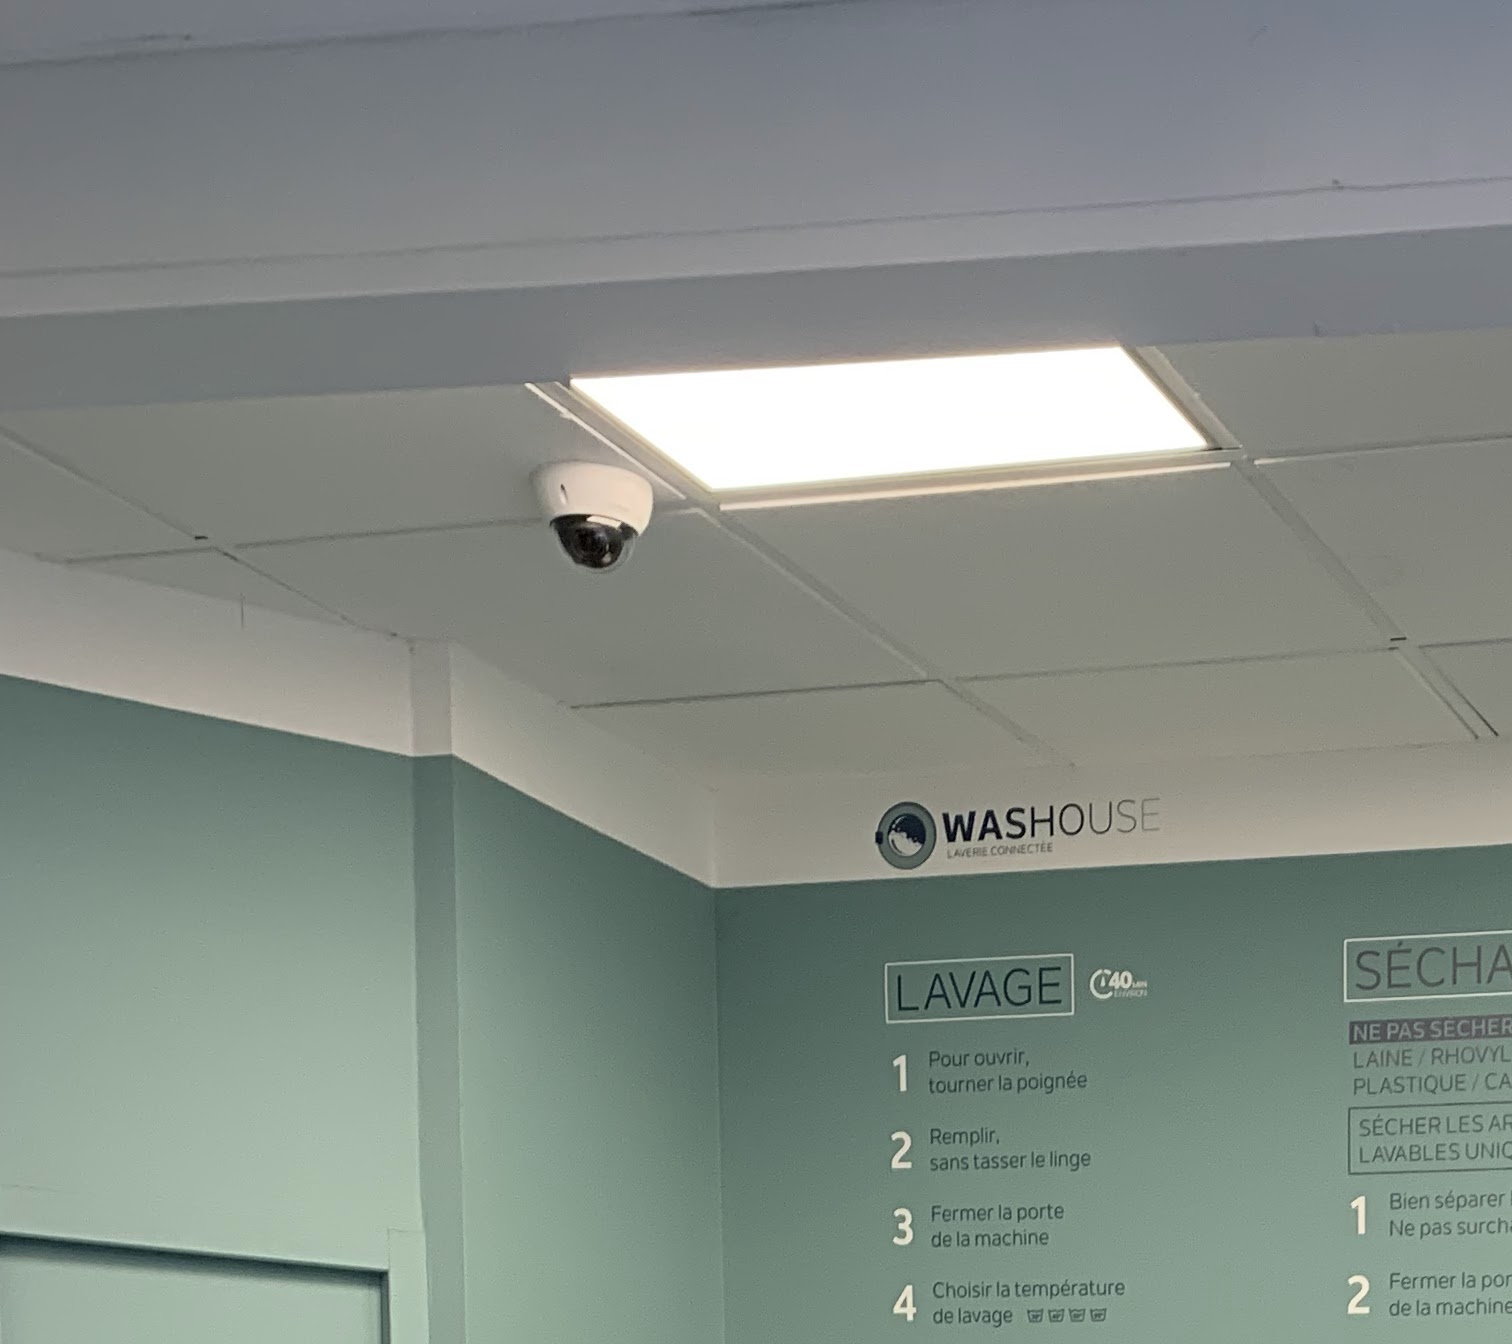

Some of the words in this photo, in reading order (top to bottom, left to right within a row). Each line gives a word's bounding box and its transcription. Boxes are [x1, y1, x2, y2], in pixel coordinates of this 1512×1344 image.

[941, 797, 1161, 844] WASHOUSE
[947, 846, 988, 859] LAVERIE
[990, 840, 1053, 856] CONNECTÉE
[897, 966, 1062, 1012] LAVAGE
[1108, 970, 1133, 990] 40
[1352, 1023, 1381, 1042] NE
[1386, 1020, 1425, 1040] PAS
[1353, 1049, 1413, 1069] LAINE
[1431, 1045, 1512, 1065] RHOVYL
[892, 1054, 908, 1093] 1
[928, 1050, 970, 1068] Pour
[973, 1047, 1030, 1068] ouvrir,
[928, 1078, 995, 1095] tourner
[998, 1074, 1013, 1091] la
[1016, 1069, 1088, 1095] poignée
[1353, 1073, 1467, 1096] PLASTIQUE
[1359, 1113, 1442, 1138] SÉCHER
[1445, 1114, 1484, 1134] LES
[890, 1131, 913, 1170] 2
[929, 1126, 1000, 1148] Remplir,
[1359, 1142, 1461, 1164] LAVABLES
[929, 1156, 970, 1172] sans
[973, 1154, 1028, 1171] tasser
[1030, 1151, 1046, 1169] le
[1049, 1150, 1092, 1172] linge
[1349, 1195, 1367, 1235] 1
[1389, 1191, 1430, 1211] Bien
[1434, 1189, 1506, 1213] séparer
[1389, 1219, 1416, 1237] Ne
[1419, 1221, 1453, 1240] pas
[892, 1284, 917, 1322] 4
[932, 1281, 993, 1299] Choisir
[996, 1281, 1011, 1298] la
[1014, 1278, 1126, 1300] température
[1346, 1275, 1371, 1315] 2
[1389, 1272, 1457, 1291] Fermer
[1461, 1271, 1477, 1289] la
[932, 1307, 954, 1325] de
[958, 1307, 1013, 1329] lavage
[1388, 1299, 1412, 1317] de
[1416, 1299, 1431, 1317] la
